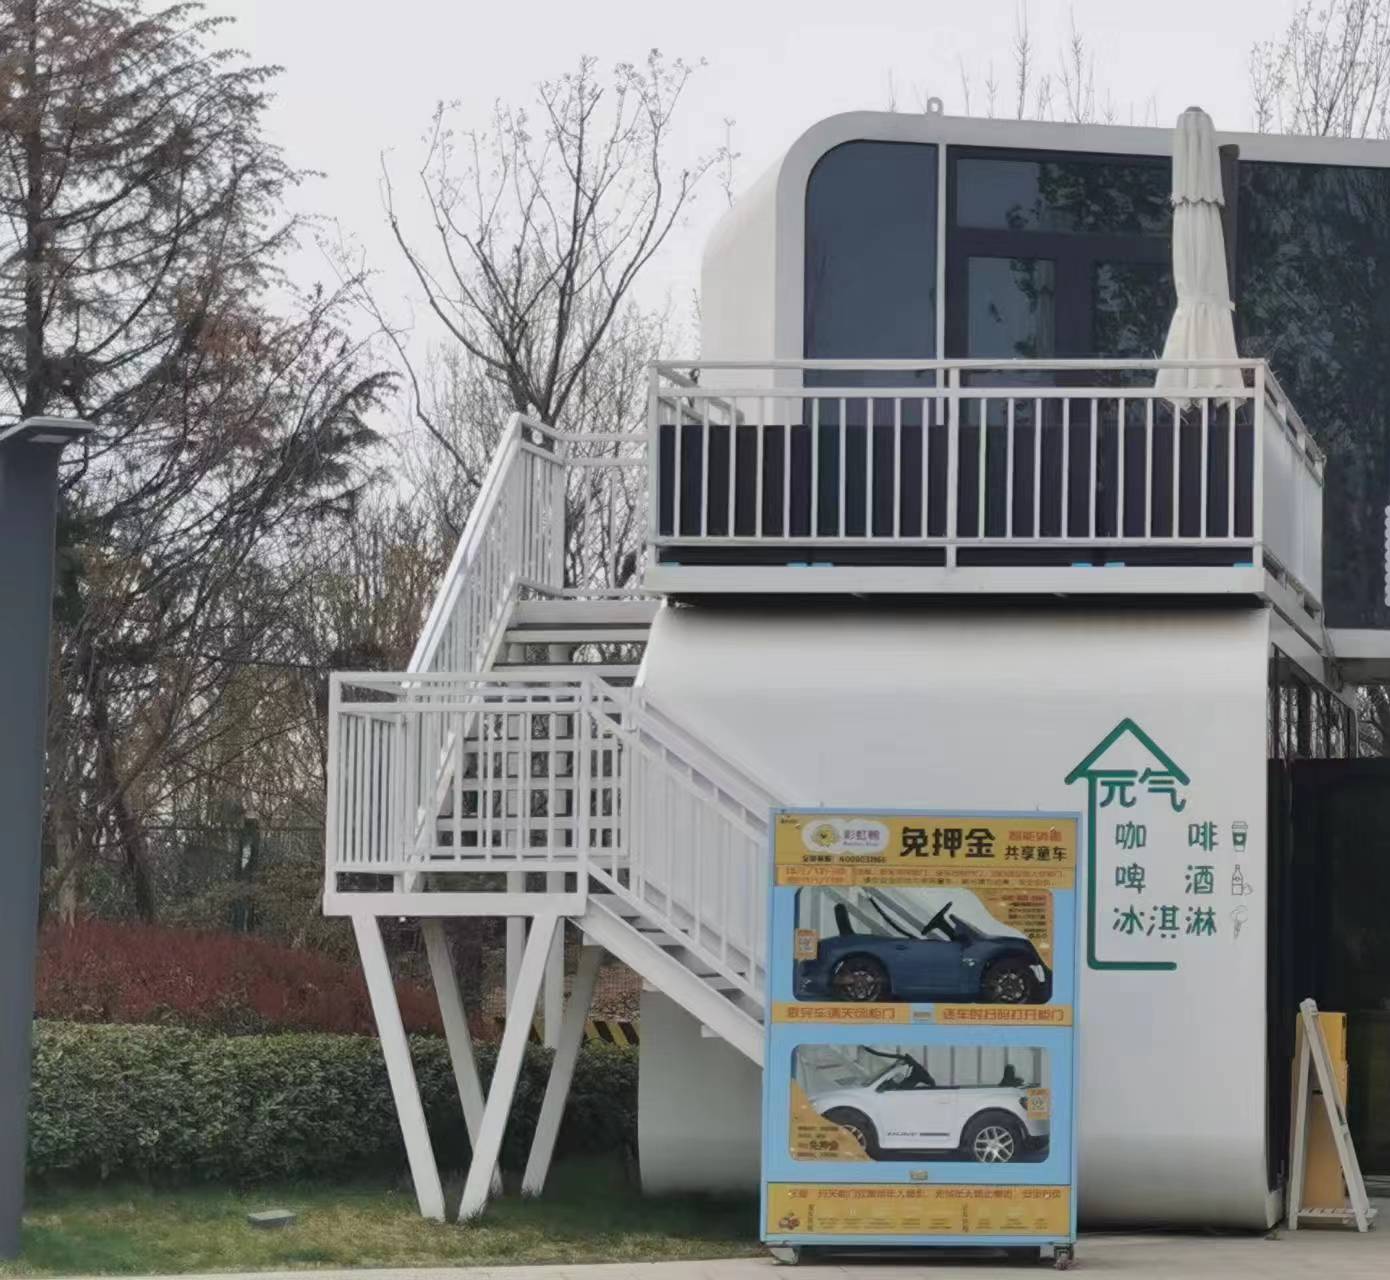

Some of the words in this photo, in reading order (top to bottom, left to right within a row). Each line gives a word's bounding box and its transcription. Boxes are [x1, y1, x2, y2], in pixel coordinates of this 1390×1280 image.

[1096, 768, 1187, 813] 元气
[899, 826, 996, 859] 免押金
[1115, 820, 1218, 852] 咖啡
[1004, 845, 1068, 861] 共享童车
[1115, 863, 1215, 895] 啤酒
[1112, 905, 1217, 939] 冰淇淋
